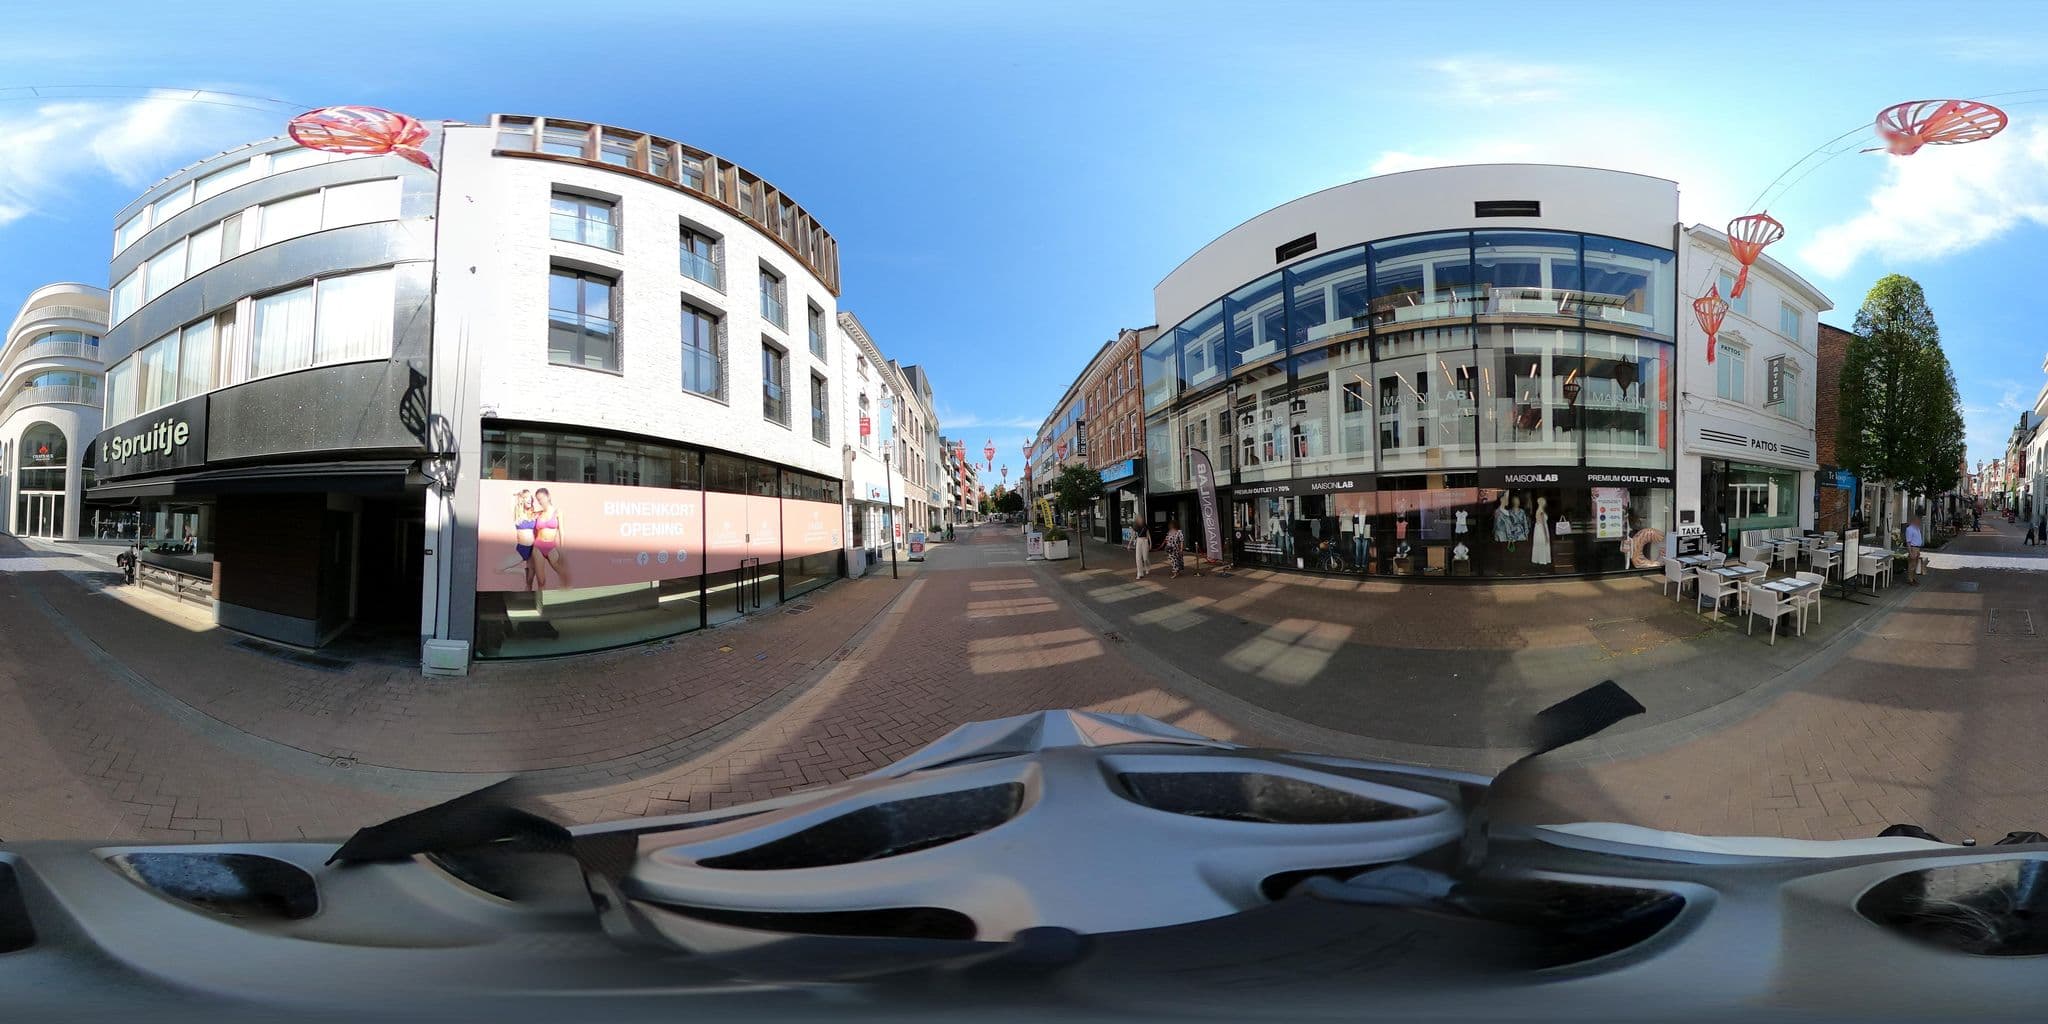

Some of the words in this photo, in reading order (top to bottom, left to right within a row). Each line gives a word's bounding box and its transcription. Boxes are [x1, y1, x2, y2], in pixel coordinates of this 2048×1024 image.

[1720, 344, 1741, 356] PATTOS
[111, 418, 189, 465] Spruitje
[1751, 438, 1778, 453] PATTOS
[1504, 474, 1559, 483] MAISONLAB
[1587, 474, 1620, 482] PREMIUM
[1621, 475, 1648, 483] OUTLET
[1253, 486, 1273, 494] OUTLET
[1312, 481, 1354, 490] MAISONLAB
[604, 501, 695, 516] BINNENKORT
[620, 521, 685, 537] OPENING
[1681, 527, 1700, 535] TAKE
